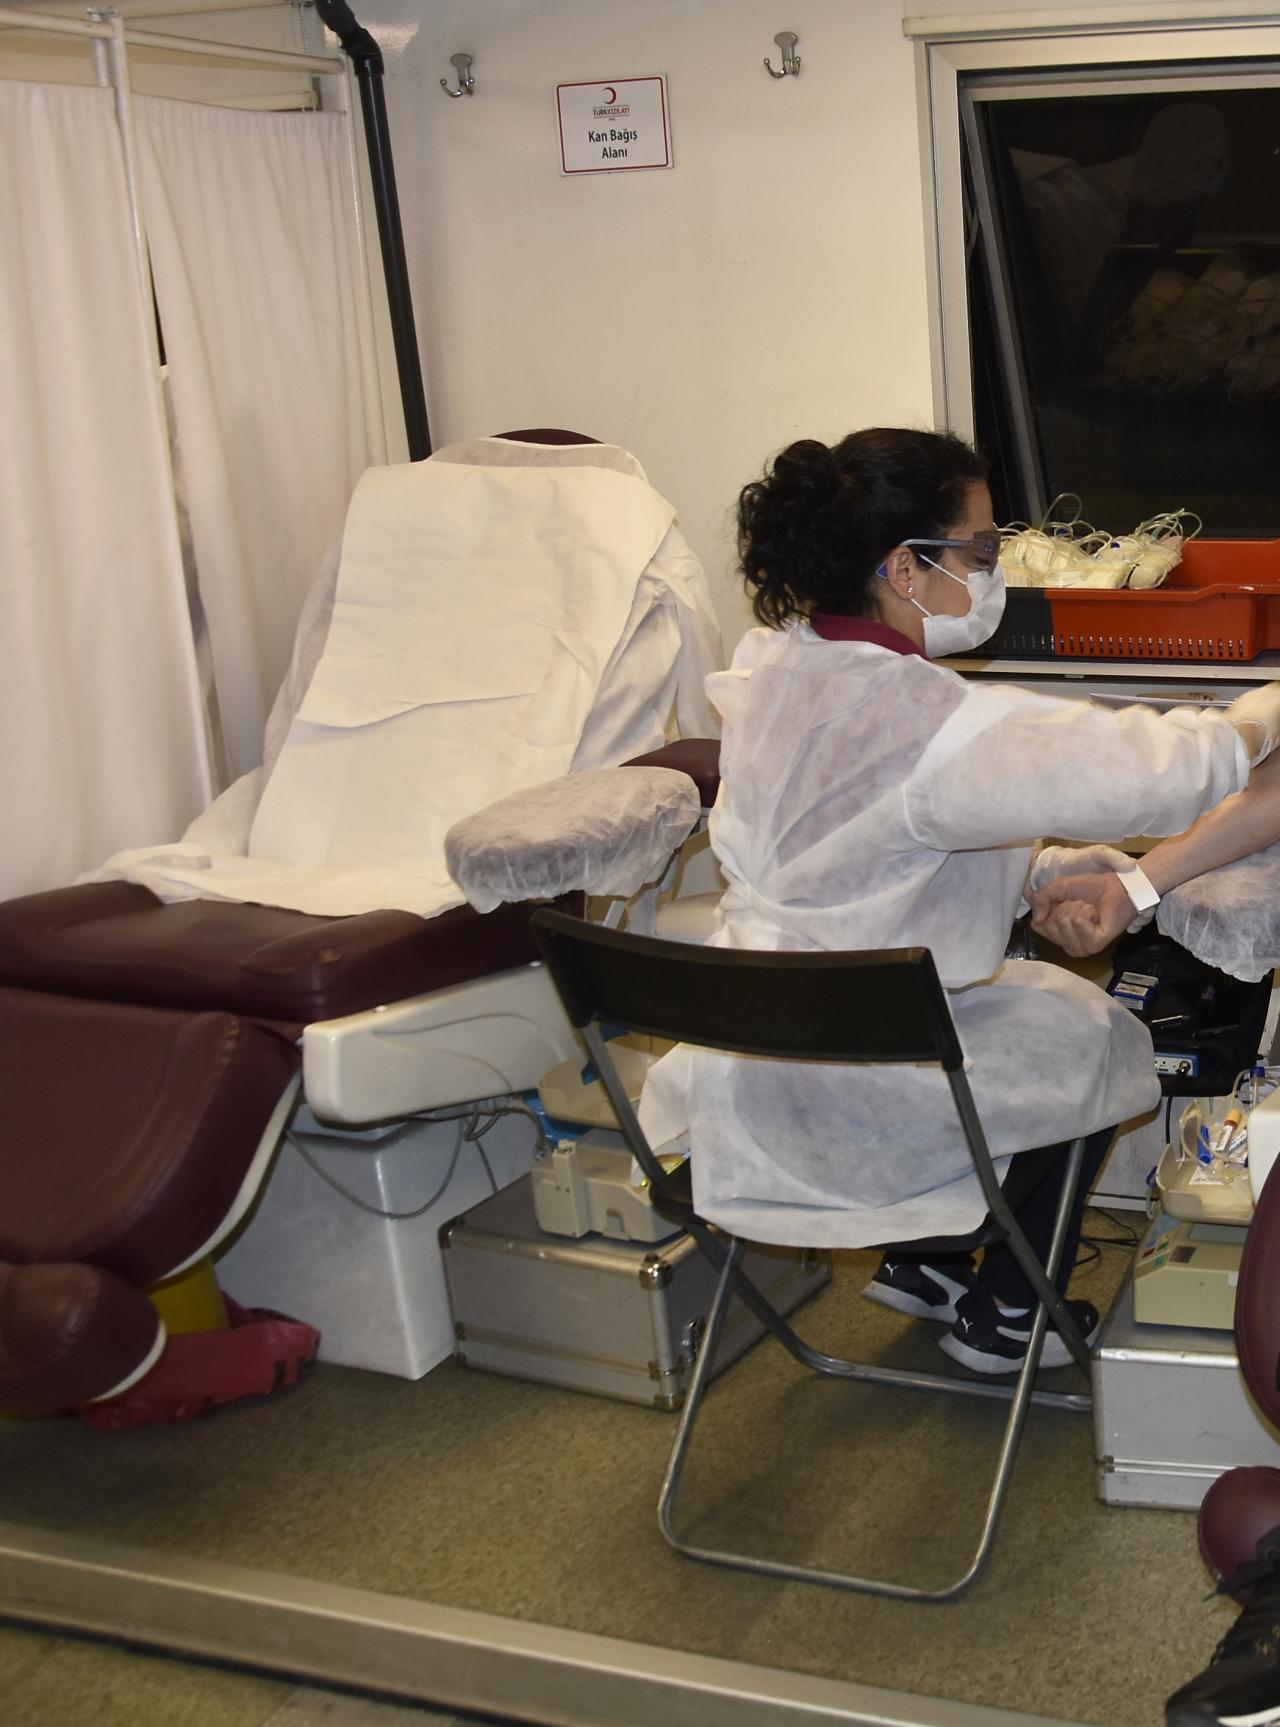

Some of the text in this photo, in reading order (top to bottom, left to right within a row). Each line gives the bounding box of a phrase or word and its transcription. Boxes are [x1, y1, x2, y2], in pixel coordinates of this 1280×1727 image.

[588, 128, 638, 143] Kan Bağış
[602, 146, 628, 159] Alanı
